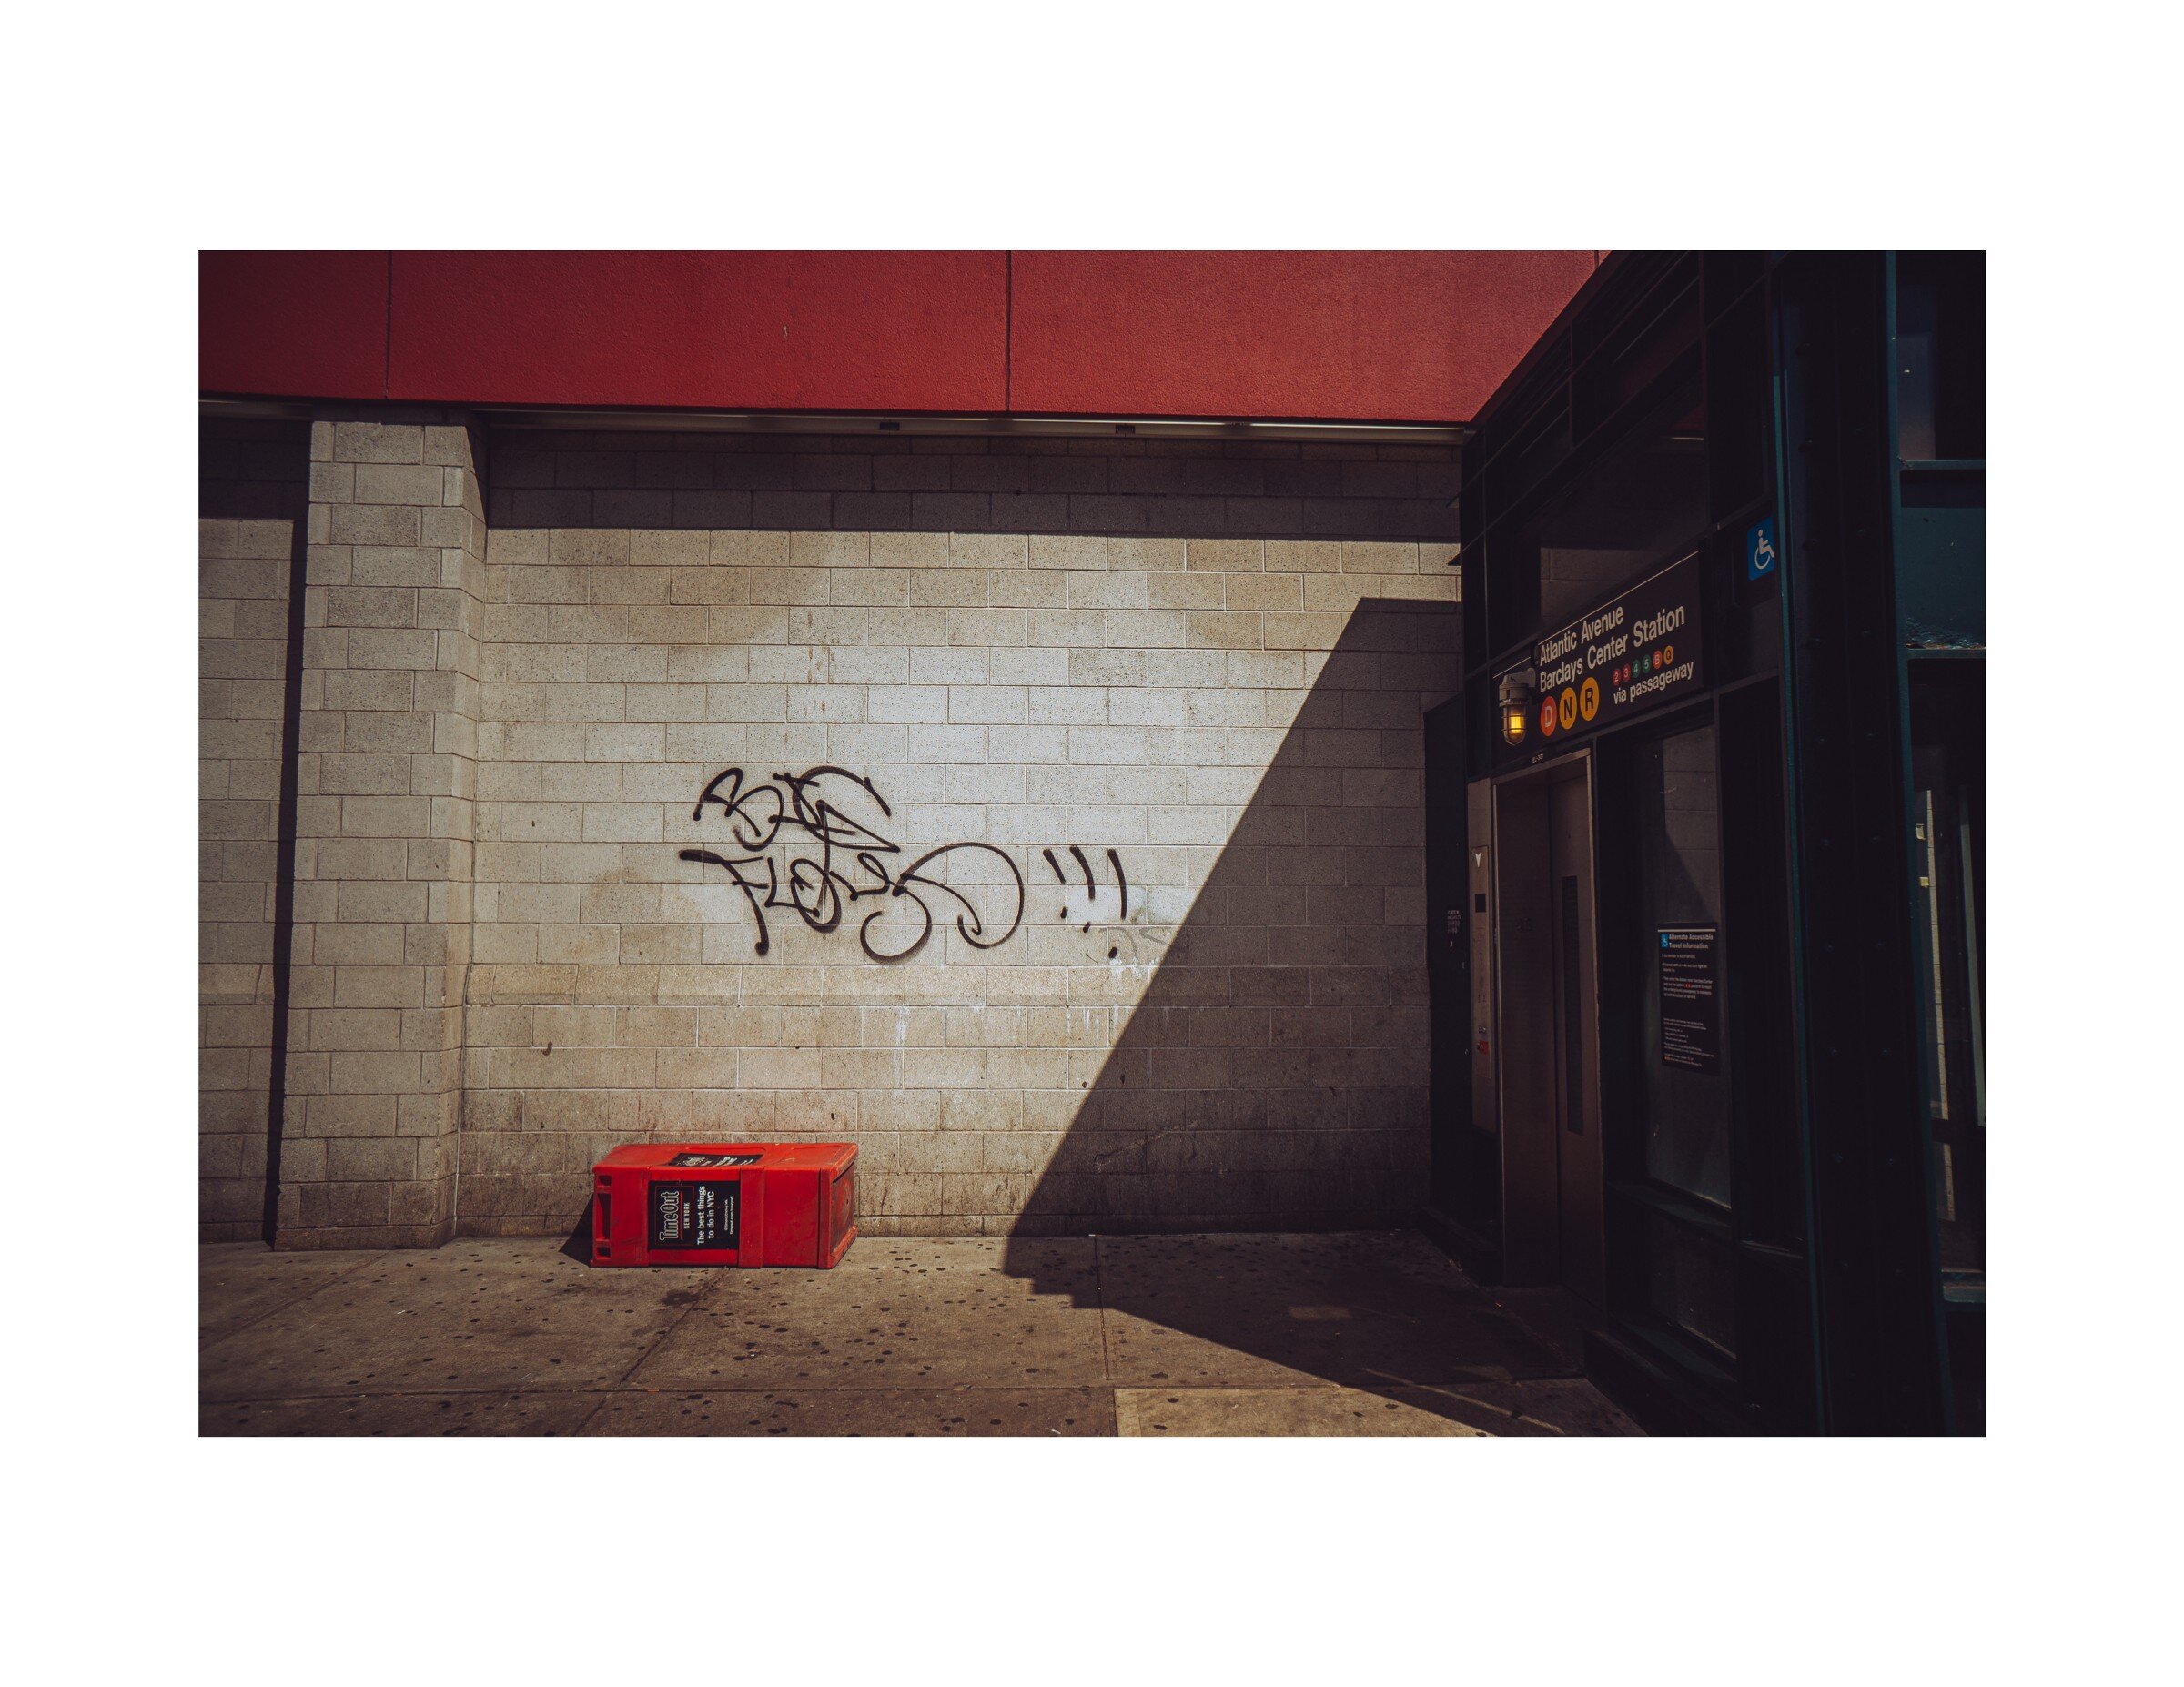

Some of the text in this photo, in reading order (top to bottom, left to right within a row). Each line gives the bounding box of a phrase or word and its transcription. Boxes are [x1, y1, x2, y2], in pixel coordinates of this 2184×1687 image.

[1539, 606, 1623, 666] Atlantic Avenue
[1540, 605, 1685, 693] Barclays Center Station
[1613, 661, 1694, 705] via passageway
[1563, 696, 1572, 721] N
[1584, 687, 1594, 712] R
[697, 1186, 707, 1245] The best things
[707, 1209, 714, 1217] in
[707, 1218, 714, 1228] do
[707, 1230, 714, 1239] to
